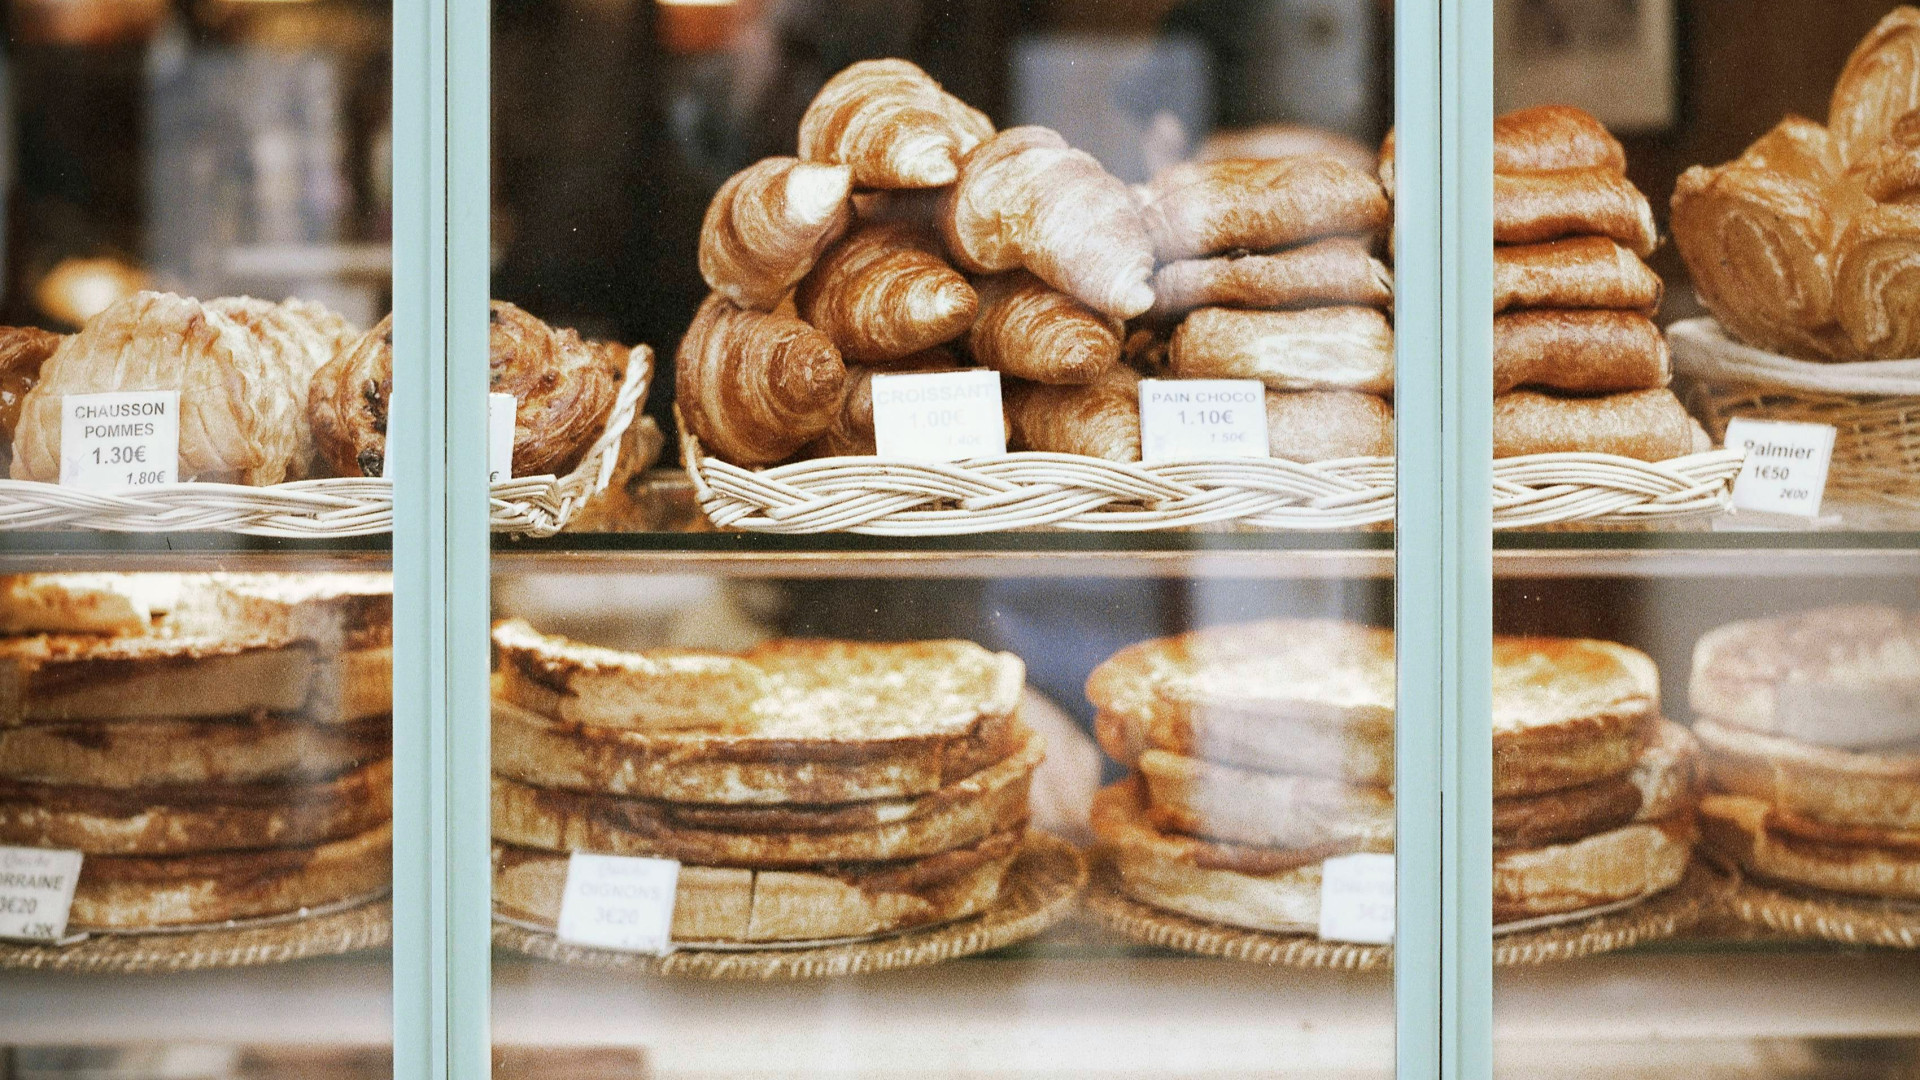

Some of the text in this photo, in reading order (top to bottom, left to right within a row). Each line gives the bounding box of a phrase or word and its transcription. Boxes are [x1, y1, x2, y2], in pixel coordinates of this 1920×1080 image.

[876, 383, 994, 405] CROISSANT
[1152, 391, 1257, 404] PAIN CHOCO
[74, 402, 165, 419] CHAUSSON
[1177, 409, 1235, 425] 1.10€
[909, 409, 966, 429] 1.00€
[84, 422, 155, 438] POMMES
[91, 445, 147, 465] 1.30€
[126, 470, 167, 486] 1.80€
[1754, 465, 1790, 481] 1€50
[578, 882, 661, 901] OIGNONS
